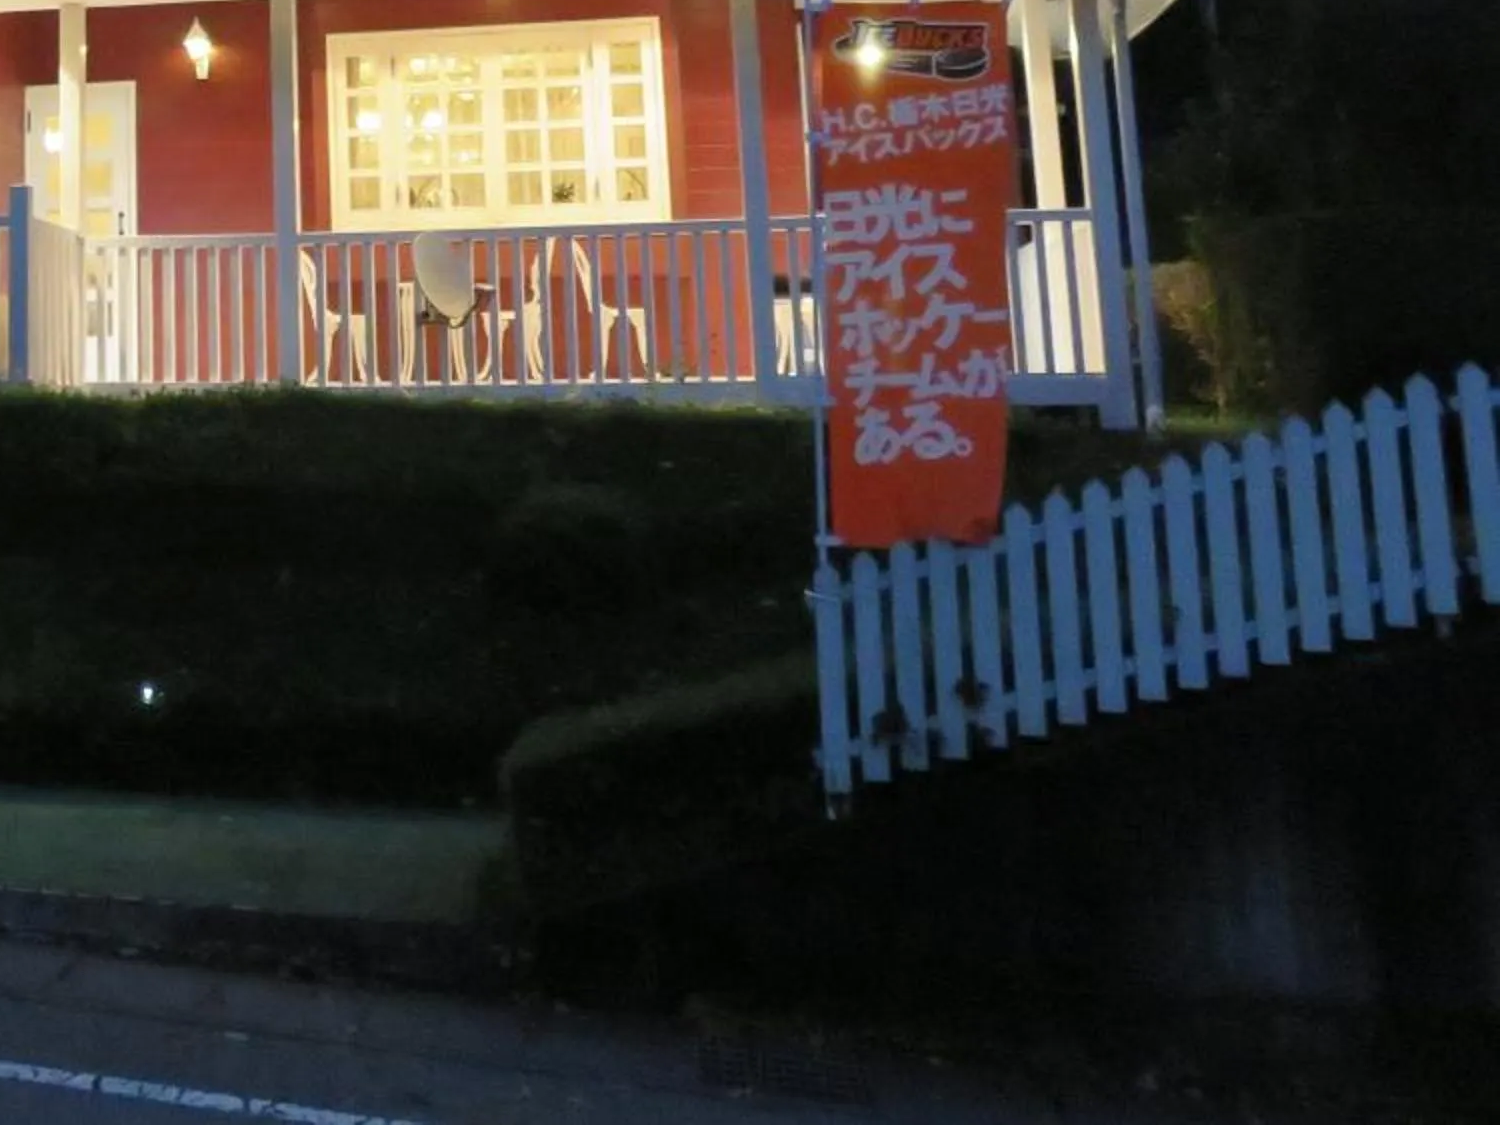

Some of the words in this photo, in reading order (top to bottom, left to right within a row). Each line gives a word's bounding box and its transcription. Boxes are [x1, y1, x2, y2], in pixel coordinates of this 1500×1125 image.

[822, 184, 973, 244] 日光に
[826, 243, 967, 300] アイス
[841, 294, 1008, 356] ホッケー
[846, 346, 1008, 408] チームが
[854, 401, 973, 466] ある。
